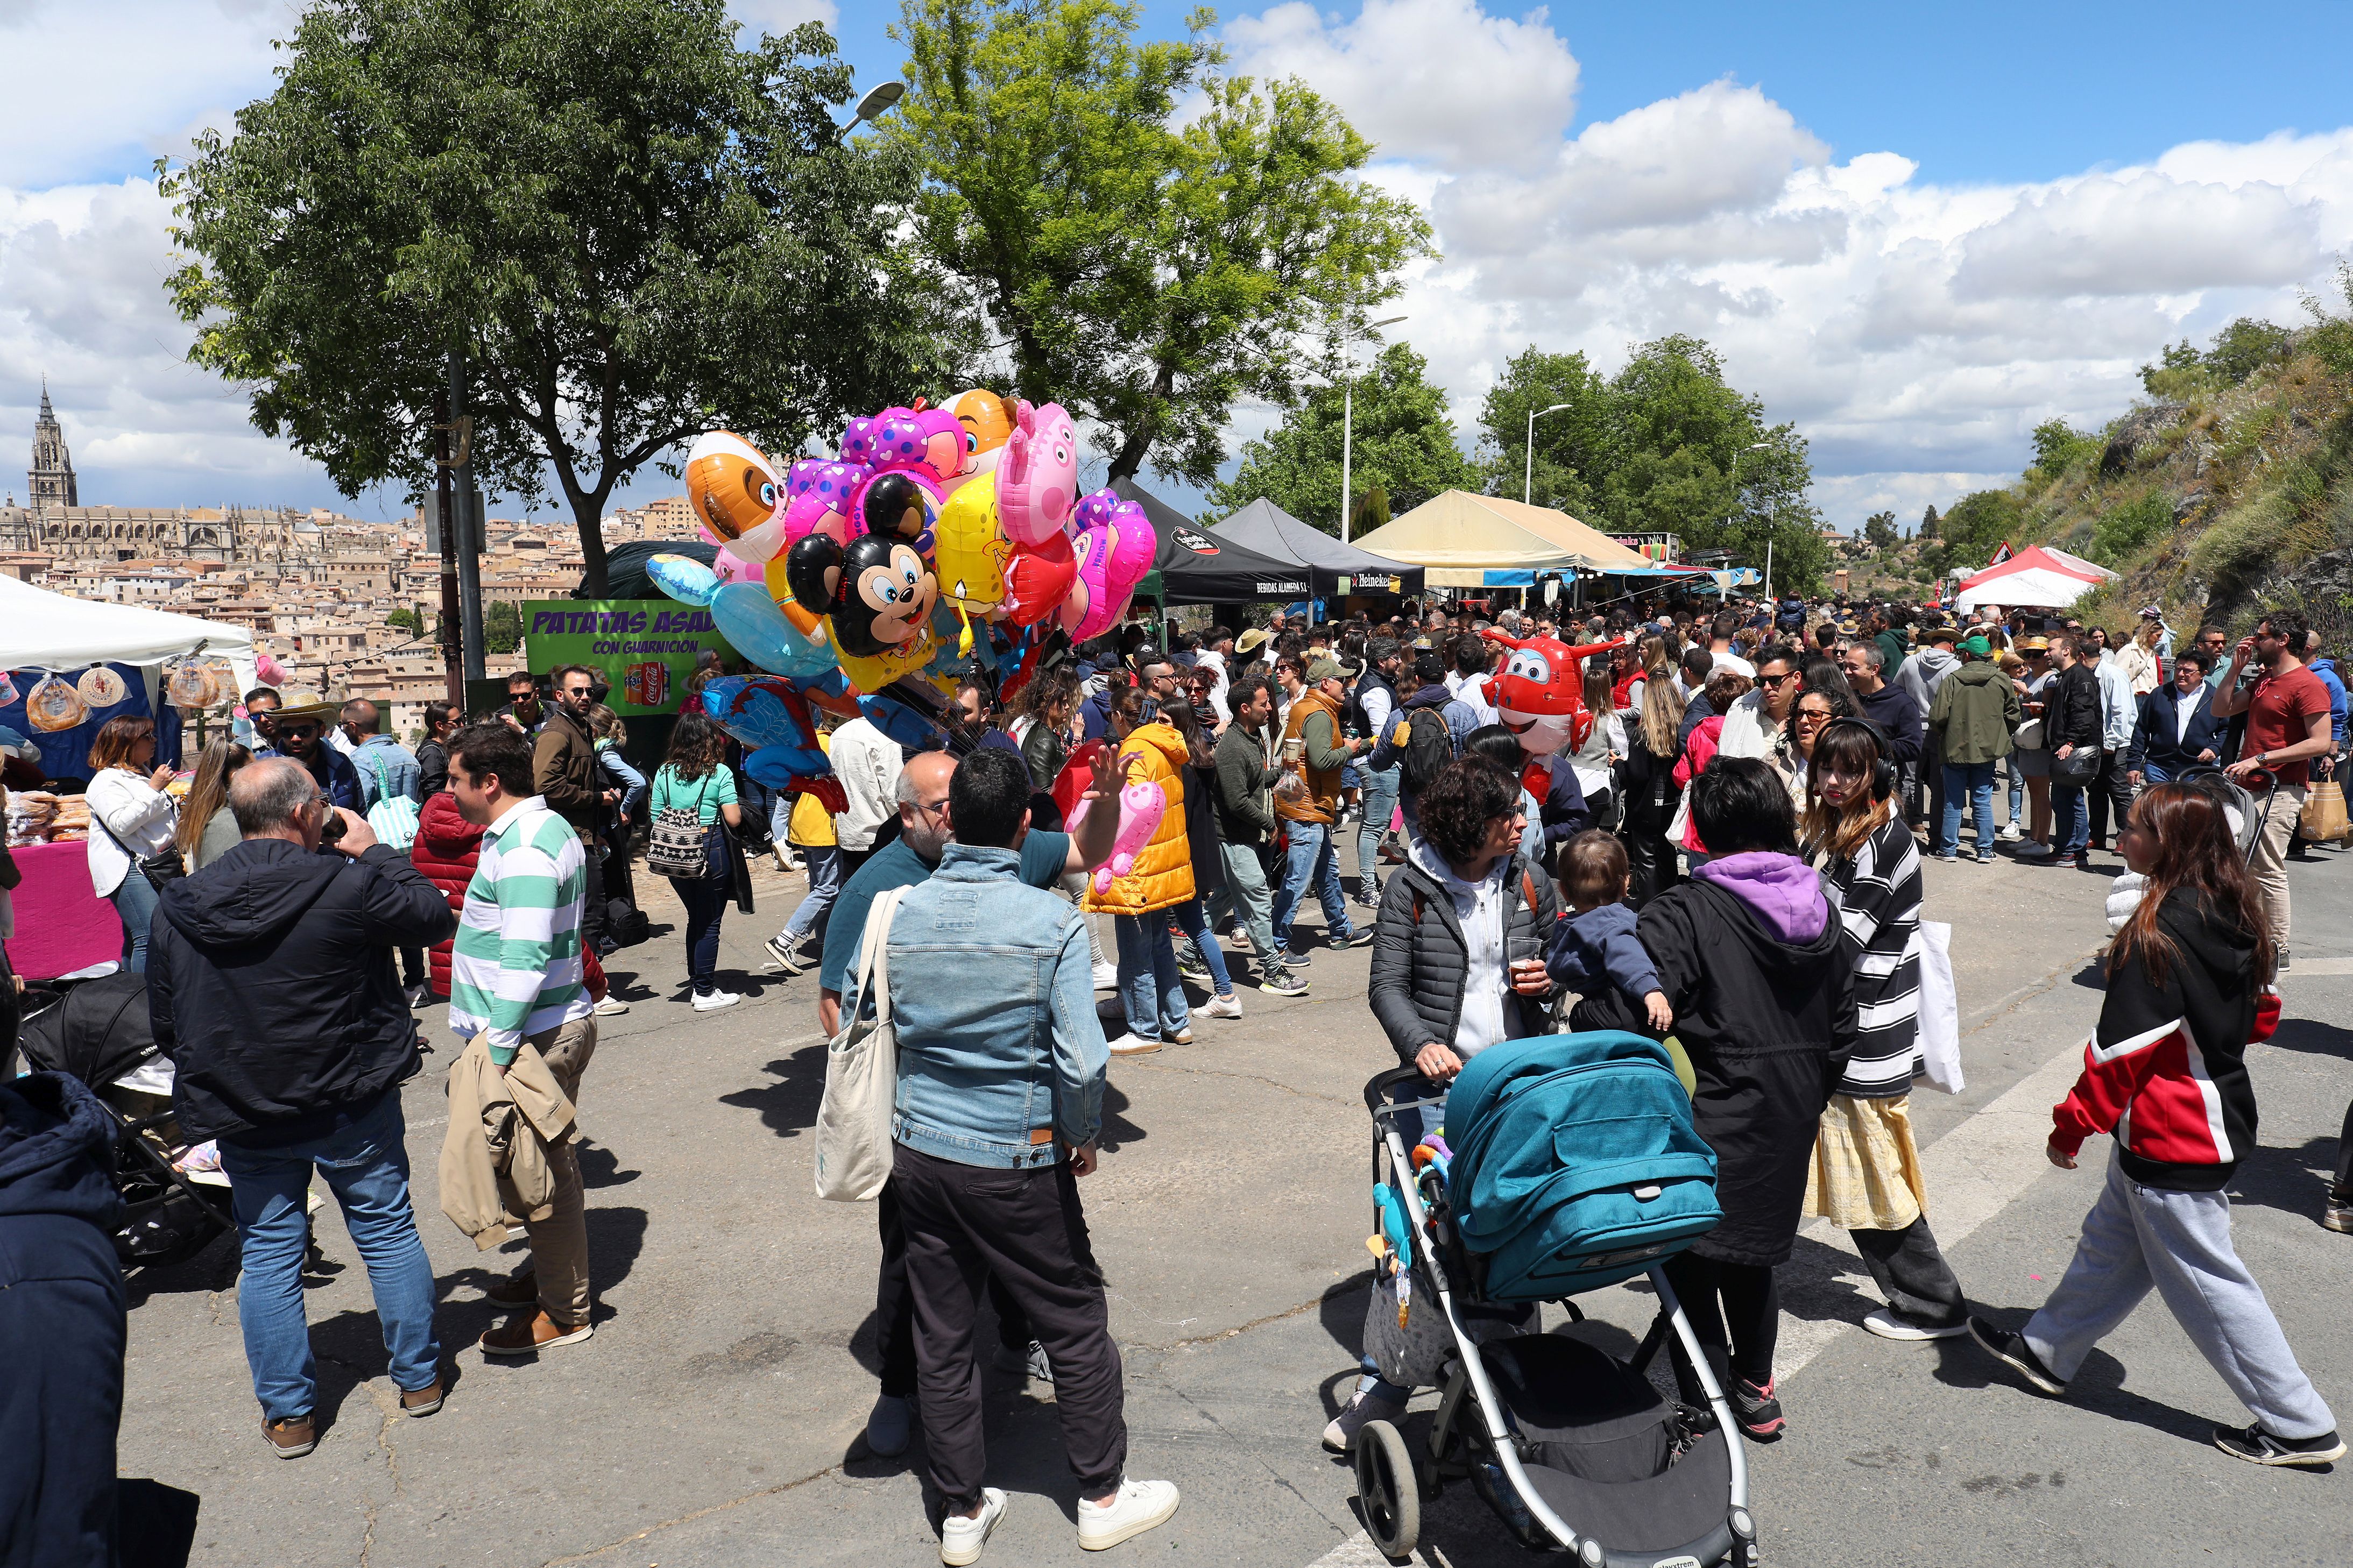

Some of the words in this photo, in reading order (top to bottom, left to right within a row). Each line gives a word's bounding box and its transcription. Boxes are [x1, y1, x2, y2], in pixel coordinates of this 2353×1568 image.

[1256, 583, 1277, 593] BEBIDAS
[1278, 582, 1300, 593] ALAMEDA
[531, 611, 647, 634] PATATAS
[592, 641, 619, 655] CON
[622, 637, 698, 654] GUARNICIÓN
[379, 779, 385, 788] OF
